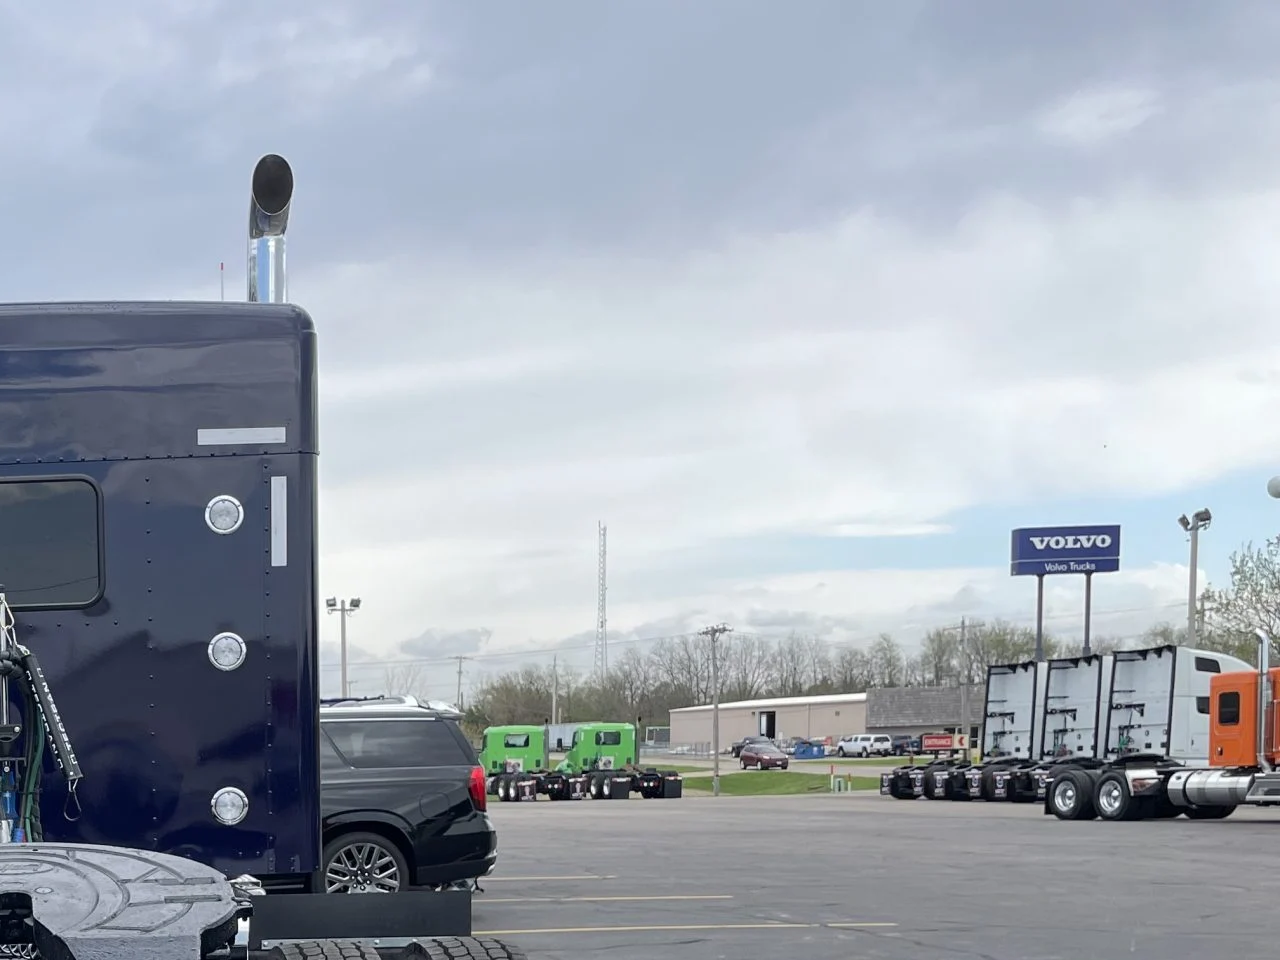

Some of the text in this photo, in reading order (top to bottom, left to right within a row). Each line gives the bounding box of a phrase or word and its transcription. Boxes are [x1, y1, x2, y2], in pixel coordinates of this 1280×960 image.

[1030, 534, 1112, 549] VOLVO
[1045, 561, 1096, 571] Volvo Trucks
[42, 682, 72, 751] TECTRAN
